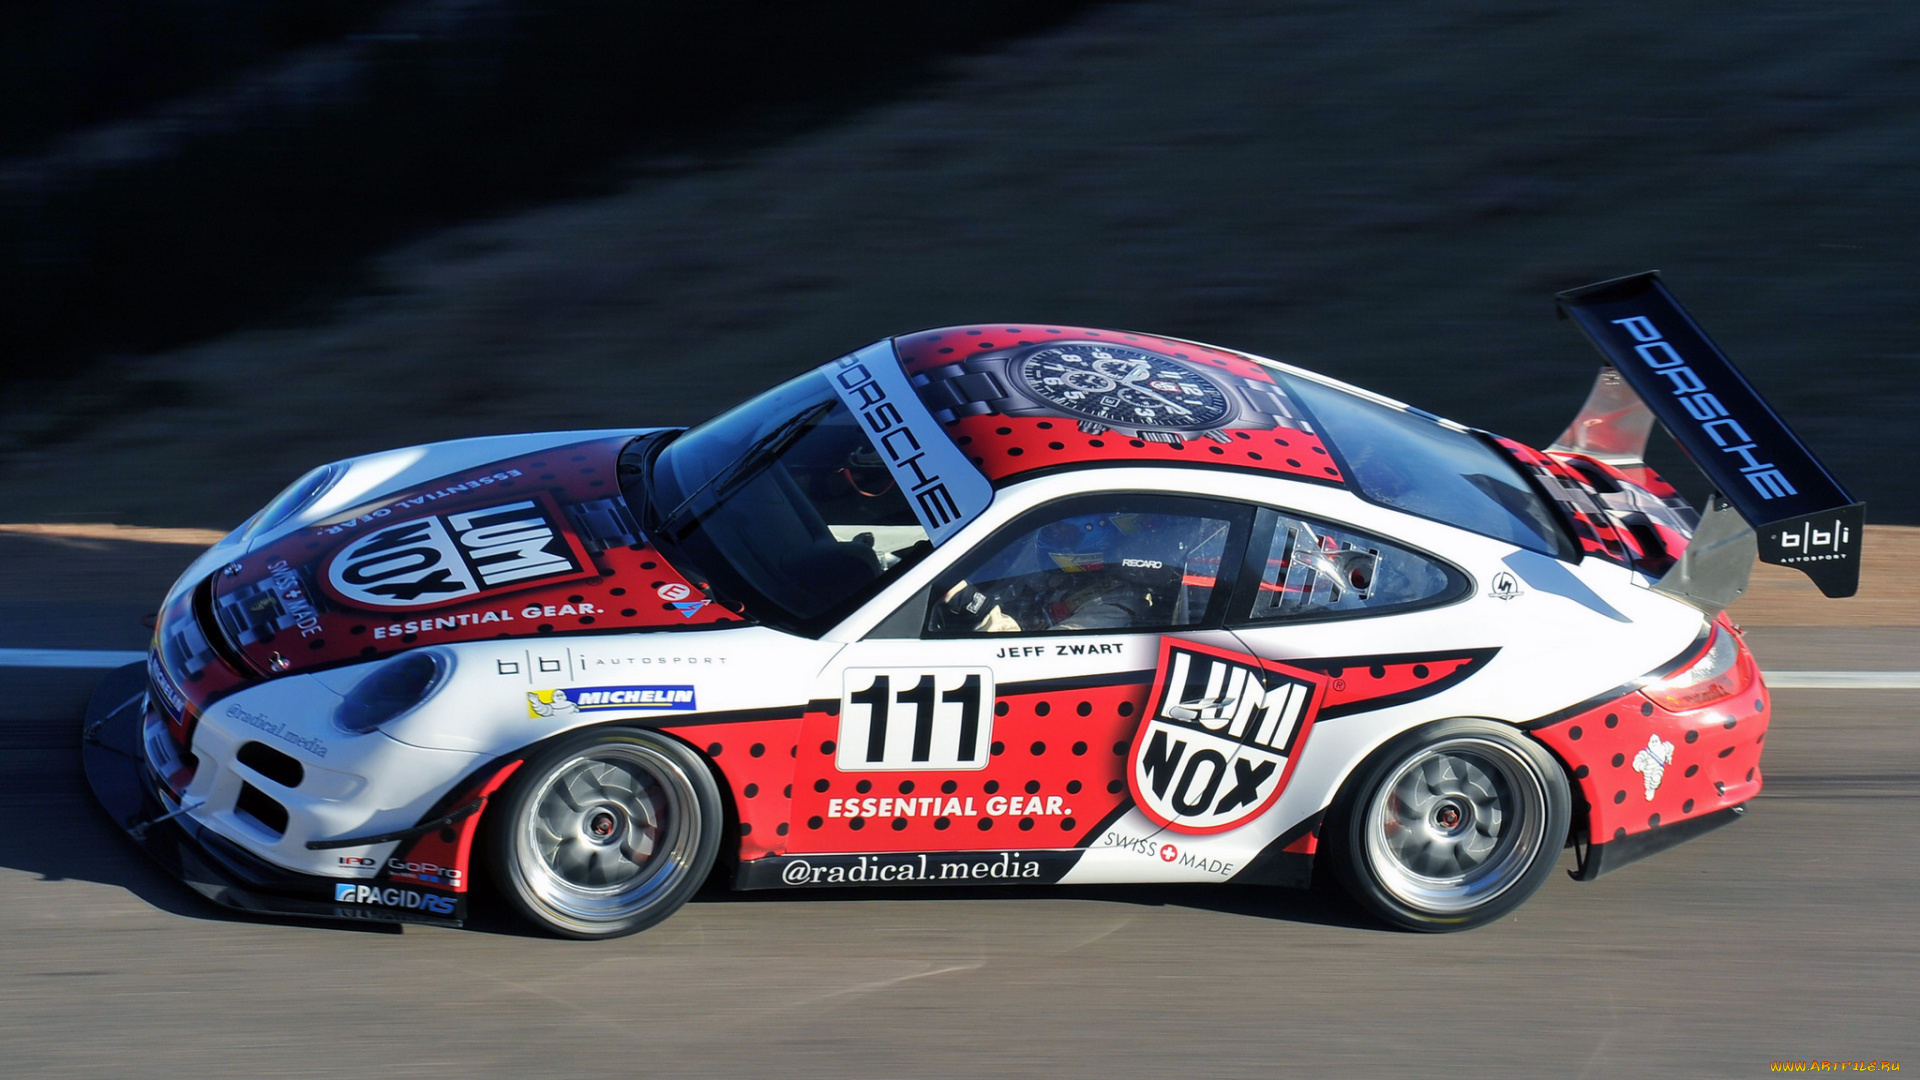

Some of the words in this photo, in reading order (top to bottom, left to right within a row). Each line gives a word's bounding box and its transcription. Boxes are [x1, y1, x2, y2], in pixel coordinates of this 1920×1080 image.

[1611, 315, 1798, 500] PORSCHE
[395, 469, 522, 510] ESSENTIAL
[342, 521, 467, 600] NOX
[447, 500, 573, 585] LUMI
[1780, 553, 1846, 563] AUTOSPORT
[1122, 559, 1162, 569] RECARO
[268, 560, 298, 590] SWISS
[287, 597, 322, 638] MADE
[374, 610, 514, 639] ESSENTIAL
[521, 602, 604, 619] GEAR.
[596, 657, 727, 665] AUTOSPORT
[997, 646, 1045, 658] JEFF
[1056, 643, 1123, 656] ZWART
[578, 690, 694, 705] MICHELIN
[851, 674, 981, 762] 111
[1161, 652, 1308, 750] LUMI
[226, 703, 328, 758] @radical.media
[1143, 729, 1277, 817] NOX
[827, 797, 977, 818] ESSENTIAL
[986, 796, 1072, 816] GEAR.
[388, 858, 462, 879] GoPro
[782, 852, 1040, 885] @radical.media
[1104, 832, 1158, 857] SWISS
[1179, 853, 1234, 876] MADE
